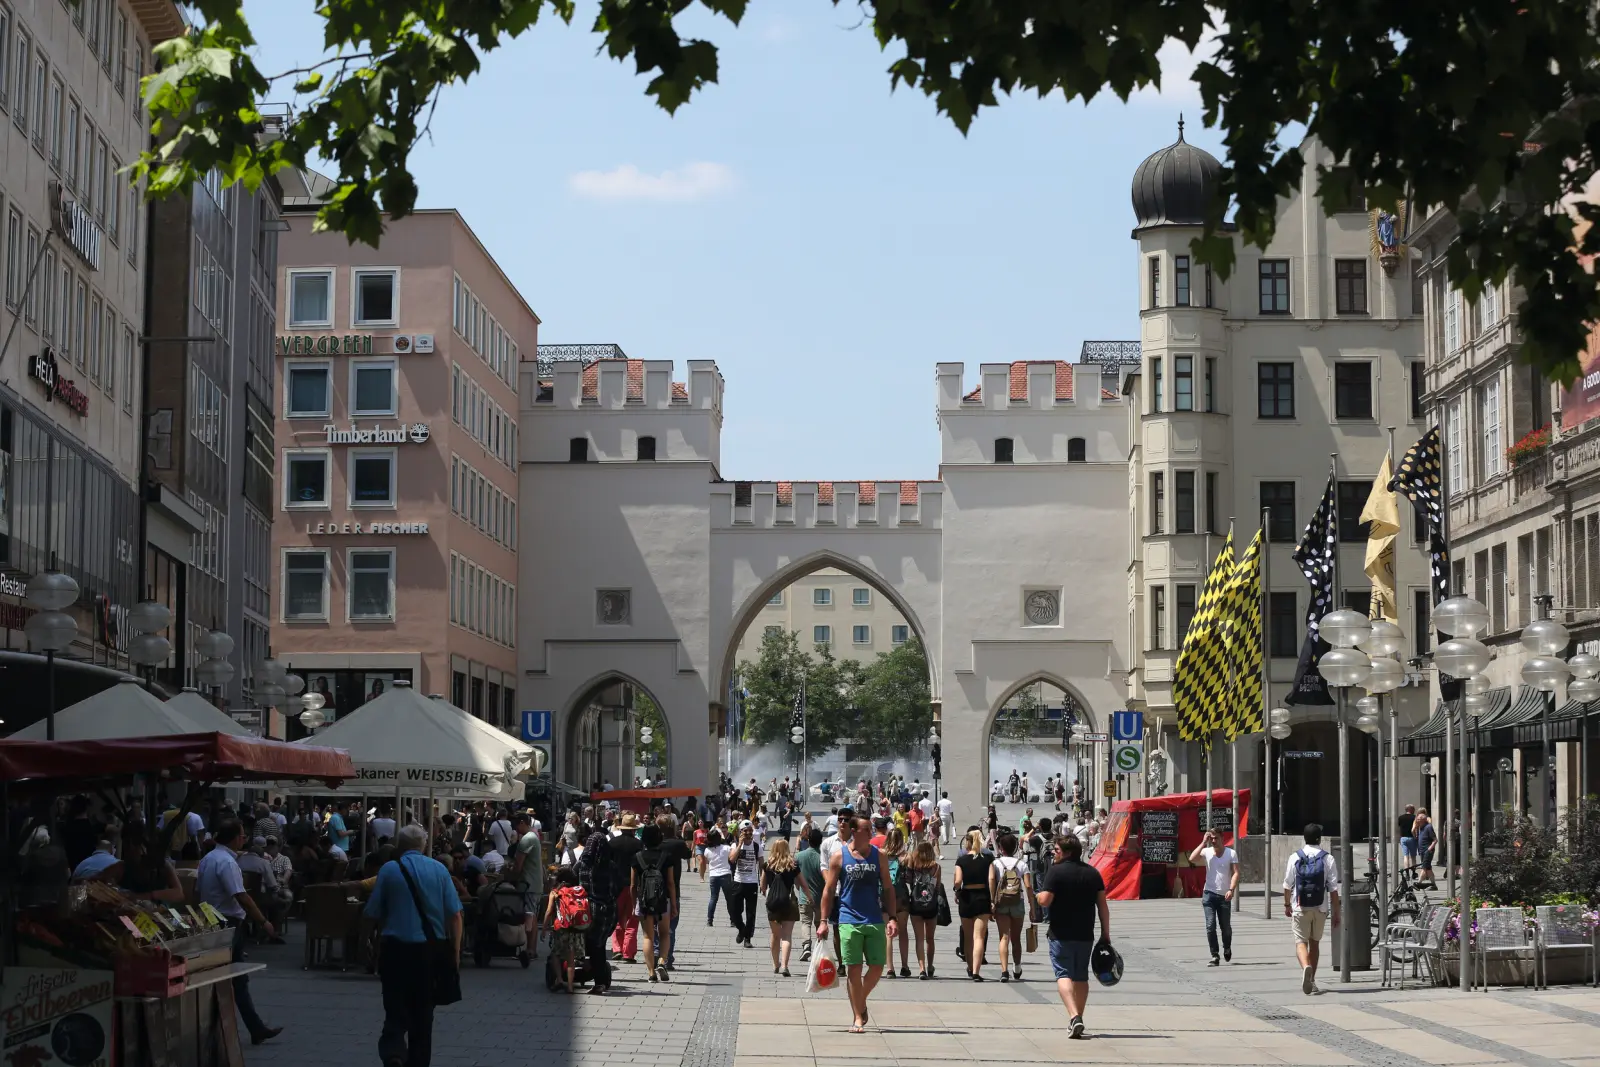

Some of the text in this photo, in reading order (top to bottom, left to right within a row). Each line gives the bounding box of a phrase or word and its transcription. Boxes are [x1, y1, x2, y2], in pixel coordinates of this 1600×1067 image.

[71, 201, 100, 271] SATURN
[275, 335, 372, 354] VERGREEN
[324, 424, 406, 443] Timberland
[306, 522, 428, 534] LEDER FISCHER
[0, 573, 28, 598] Restaur
[527, 712, 546, 738] U
[1119, 713, 1137, 738] U
[1120, 748, 1136, 768] S
[354, 767, 489, 786] skaner WEISSBIER
[845, 863, 876, 873] G-STAR
[847, 871, 865, 879] RAW
[15, 970, 77, 1004] frische
[3, 981, 111, 1030] Erdbeeren
